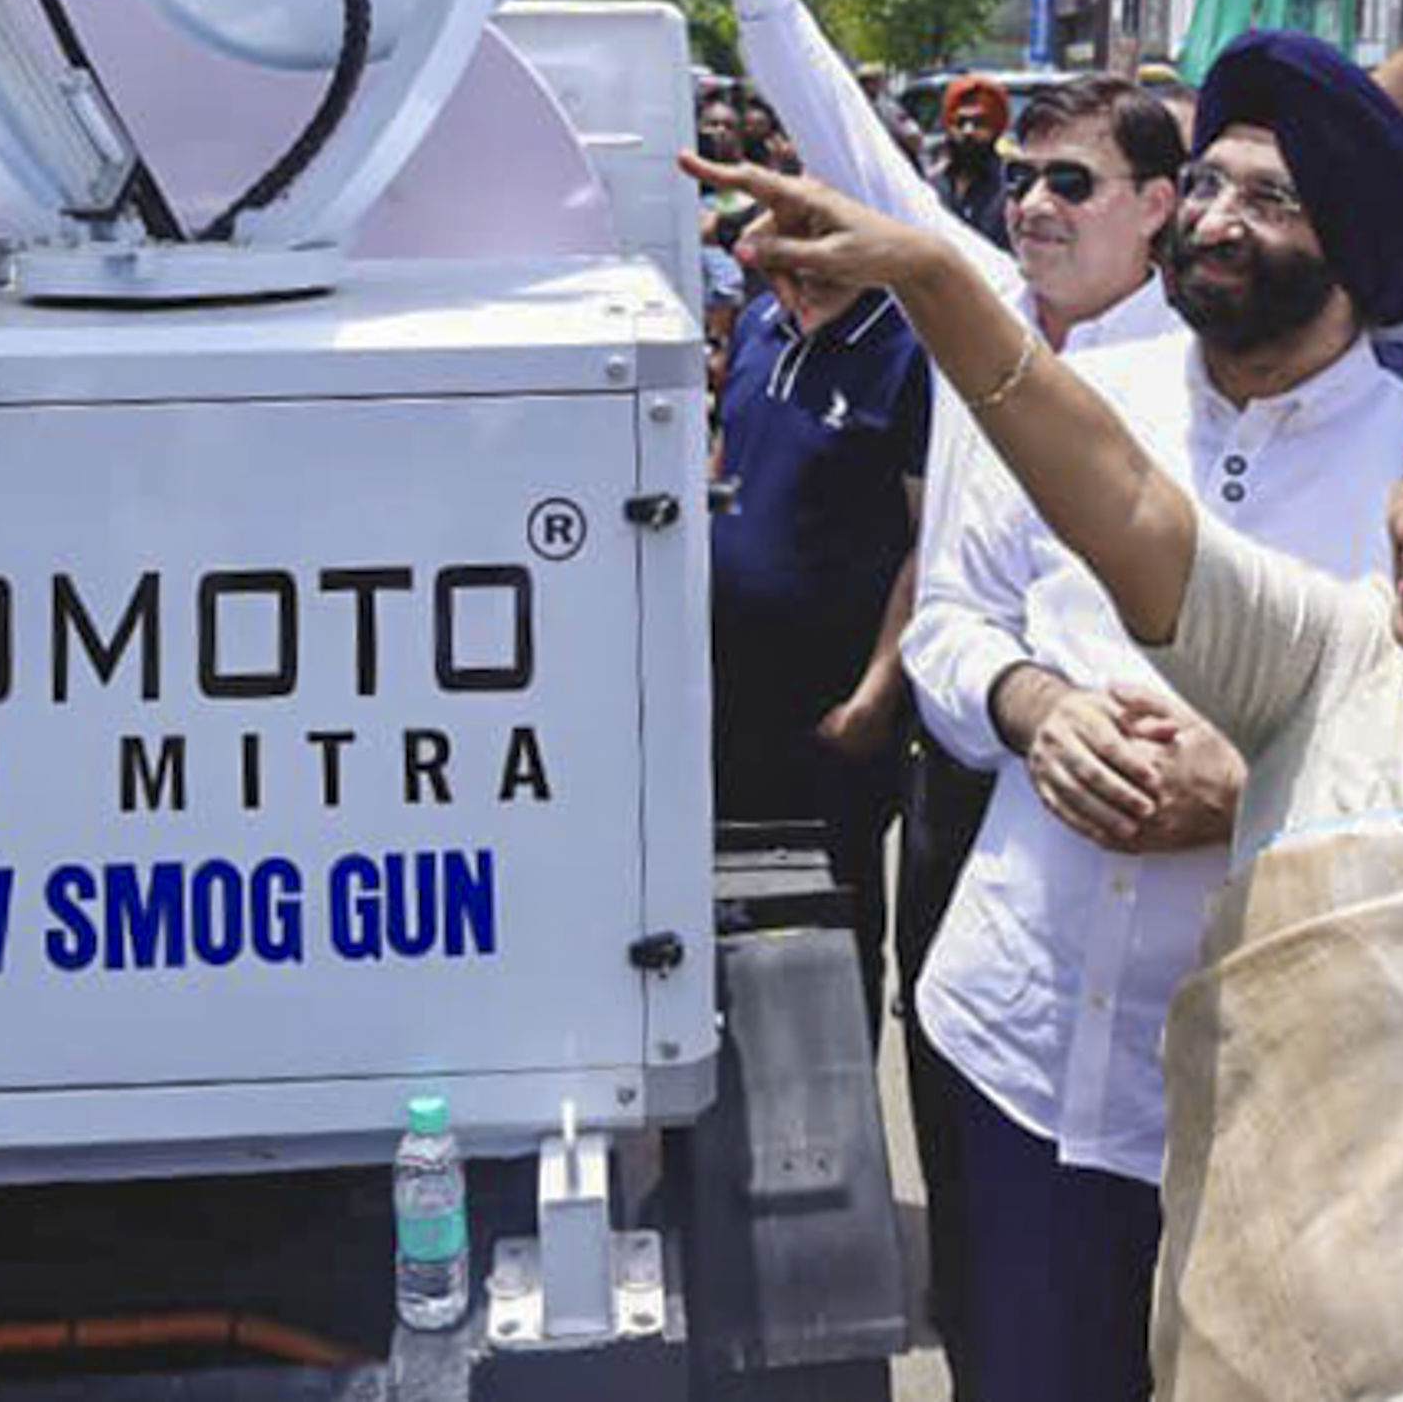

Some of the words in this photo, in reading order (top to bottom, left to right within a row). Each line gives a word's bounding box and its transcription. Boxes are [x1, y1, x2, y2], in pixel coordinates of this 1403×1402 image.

[120, 726, 552, 812] MITRA
[43, 856, 303, 972] SMOG
[329, 849, 496, 963] GUN
